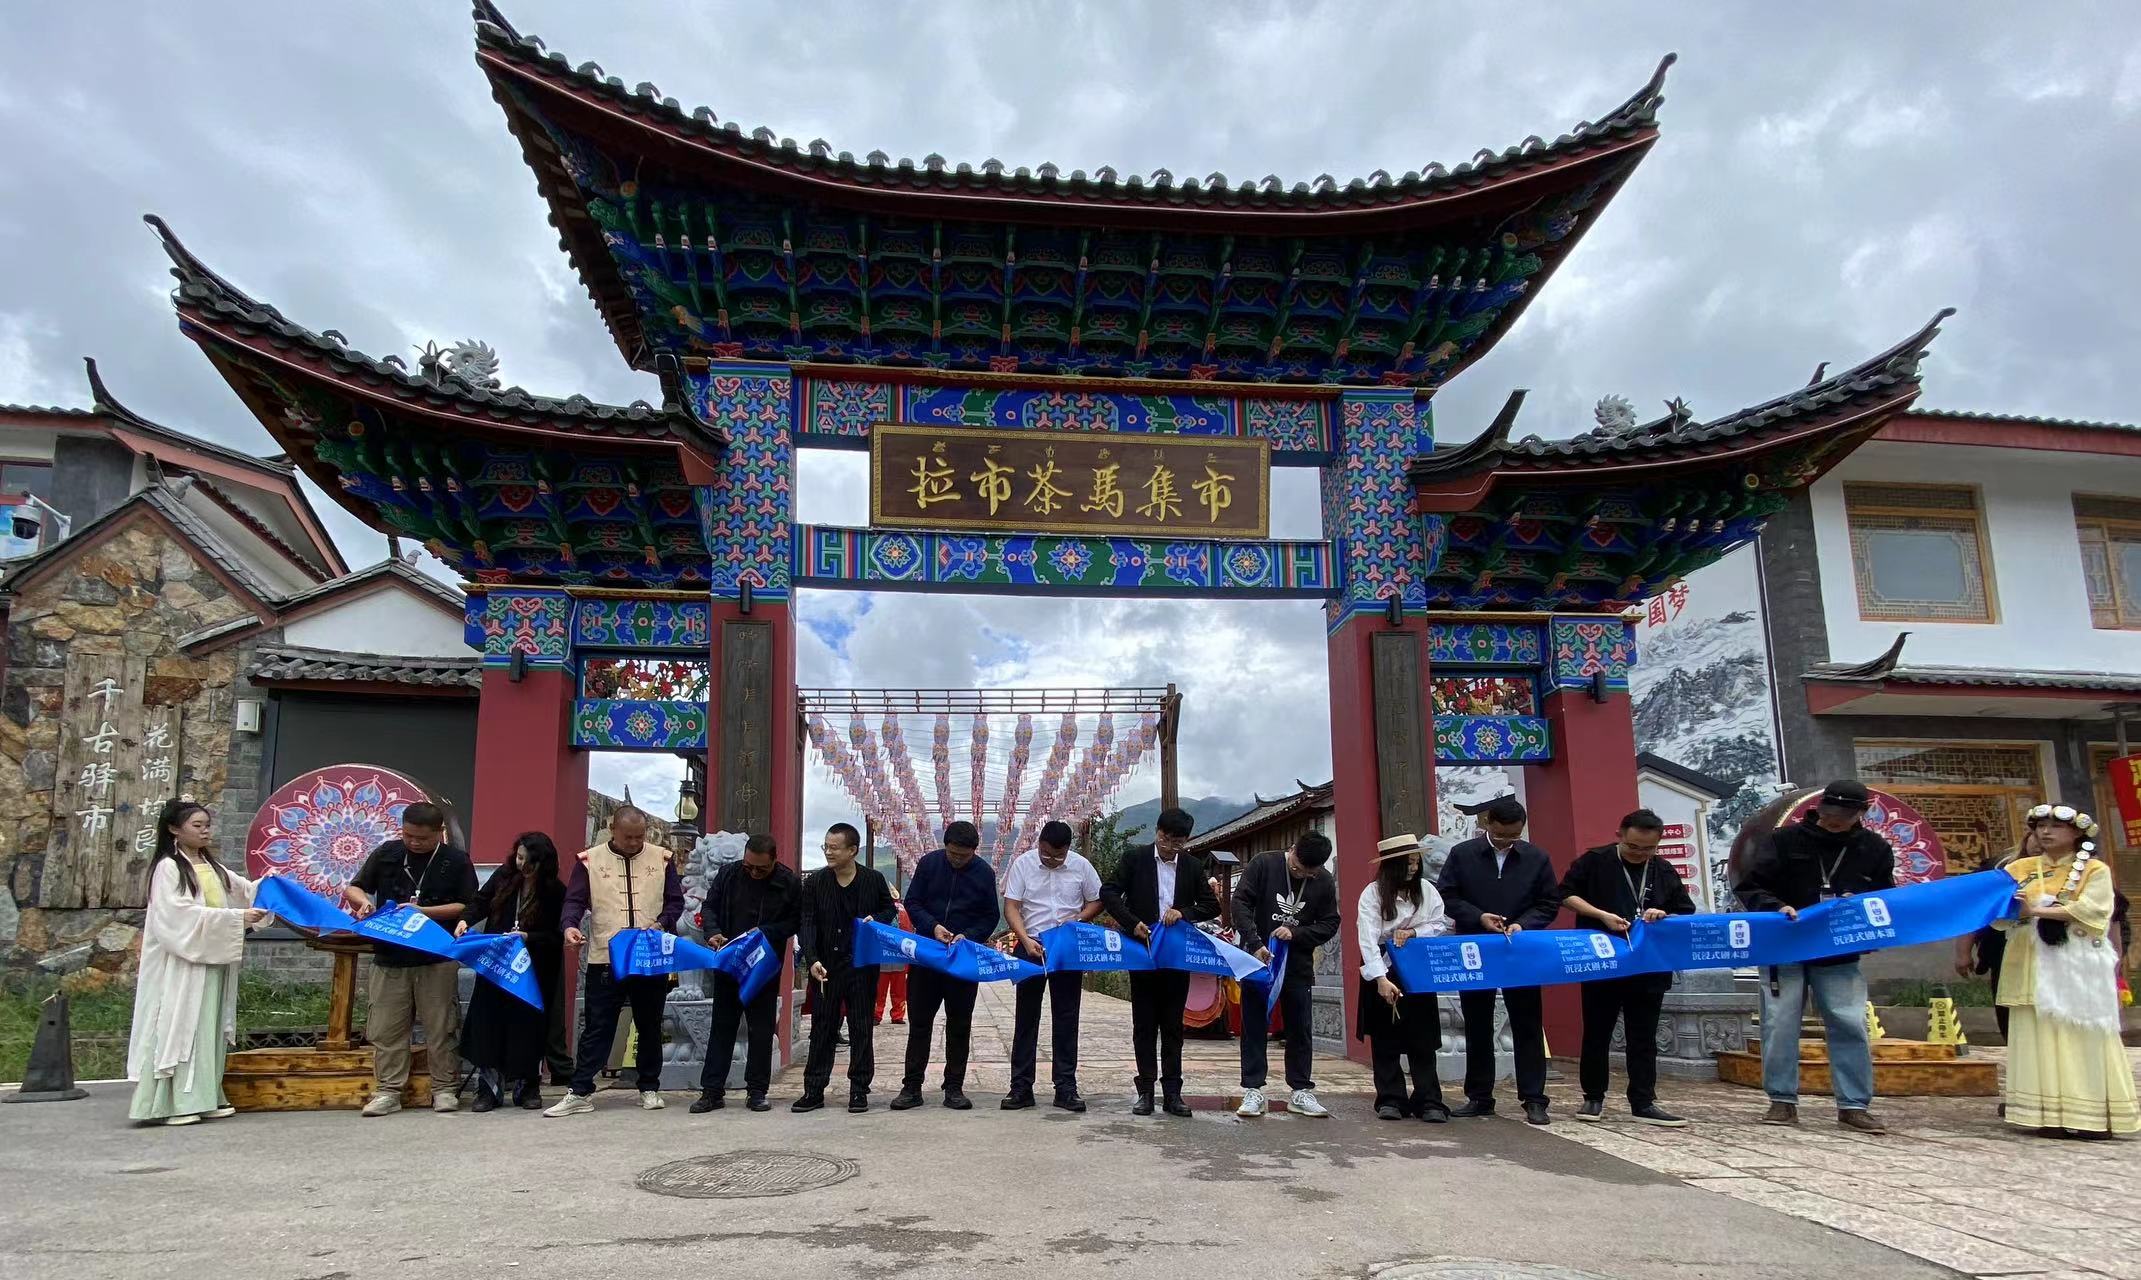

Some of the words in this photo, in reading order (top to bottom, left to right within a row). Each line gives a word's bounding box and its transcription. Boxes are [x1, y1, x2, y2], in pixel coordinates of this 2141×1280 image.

[906, 456, 1235, 523] 拉市茶馬集市
[1631, 584, 1690, 628] 国梦
[75, 678, 124, 838] 千古驿市
